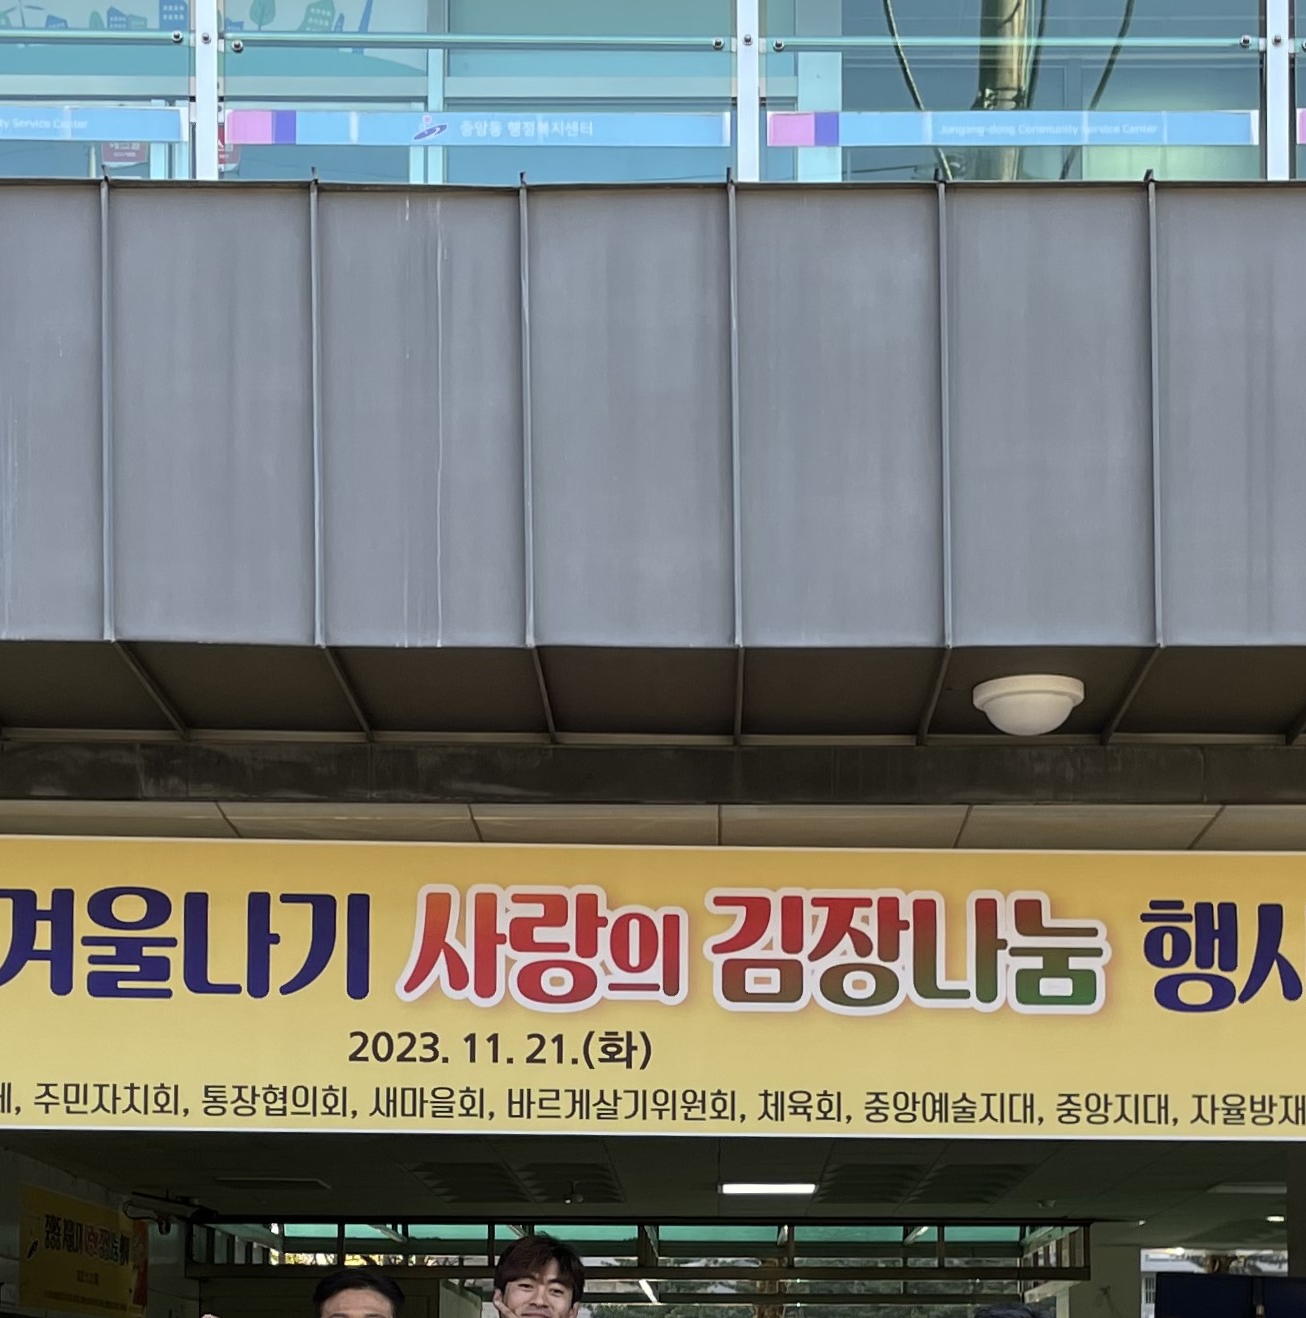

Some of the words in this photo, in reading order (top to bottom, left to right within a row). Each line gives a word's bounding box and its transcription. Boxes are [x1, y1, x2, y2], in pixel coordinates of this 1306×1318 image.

[13, 115, 51, 129] Service
[459, 120, 503, 138] 중앙동
[506, 121, 594, 138] 행정복지센터
[1018, 124, 1079, 136] Community
[1122, 123, 1159, 134] Center
[401, 889, 683, 1003] 사랑의
[709, 892, 1107, 1008] 김장나눔
[348, 1031, 450, 1064] 2023.
[462, 1033, 515, 1065] 11.
[525, 1030, 653, 1069] 21.(화)
[33, 1081, 190, 1117] 주민자치회,
[201, 1084, 358, 1119] 통장협의회,
[369, 1086, 496, 1122] 새마을회,
[506, 1088, 747, 1123] 바르게살기위원회,
[757, 1088, 853, 1124] 체육회,
[863, 1091, 1045, 1126] 중앙예술지대,
[1055, 1092, 1180, 1127] 중앙지대,
